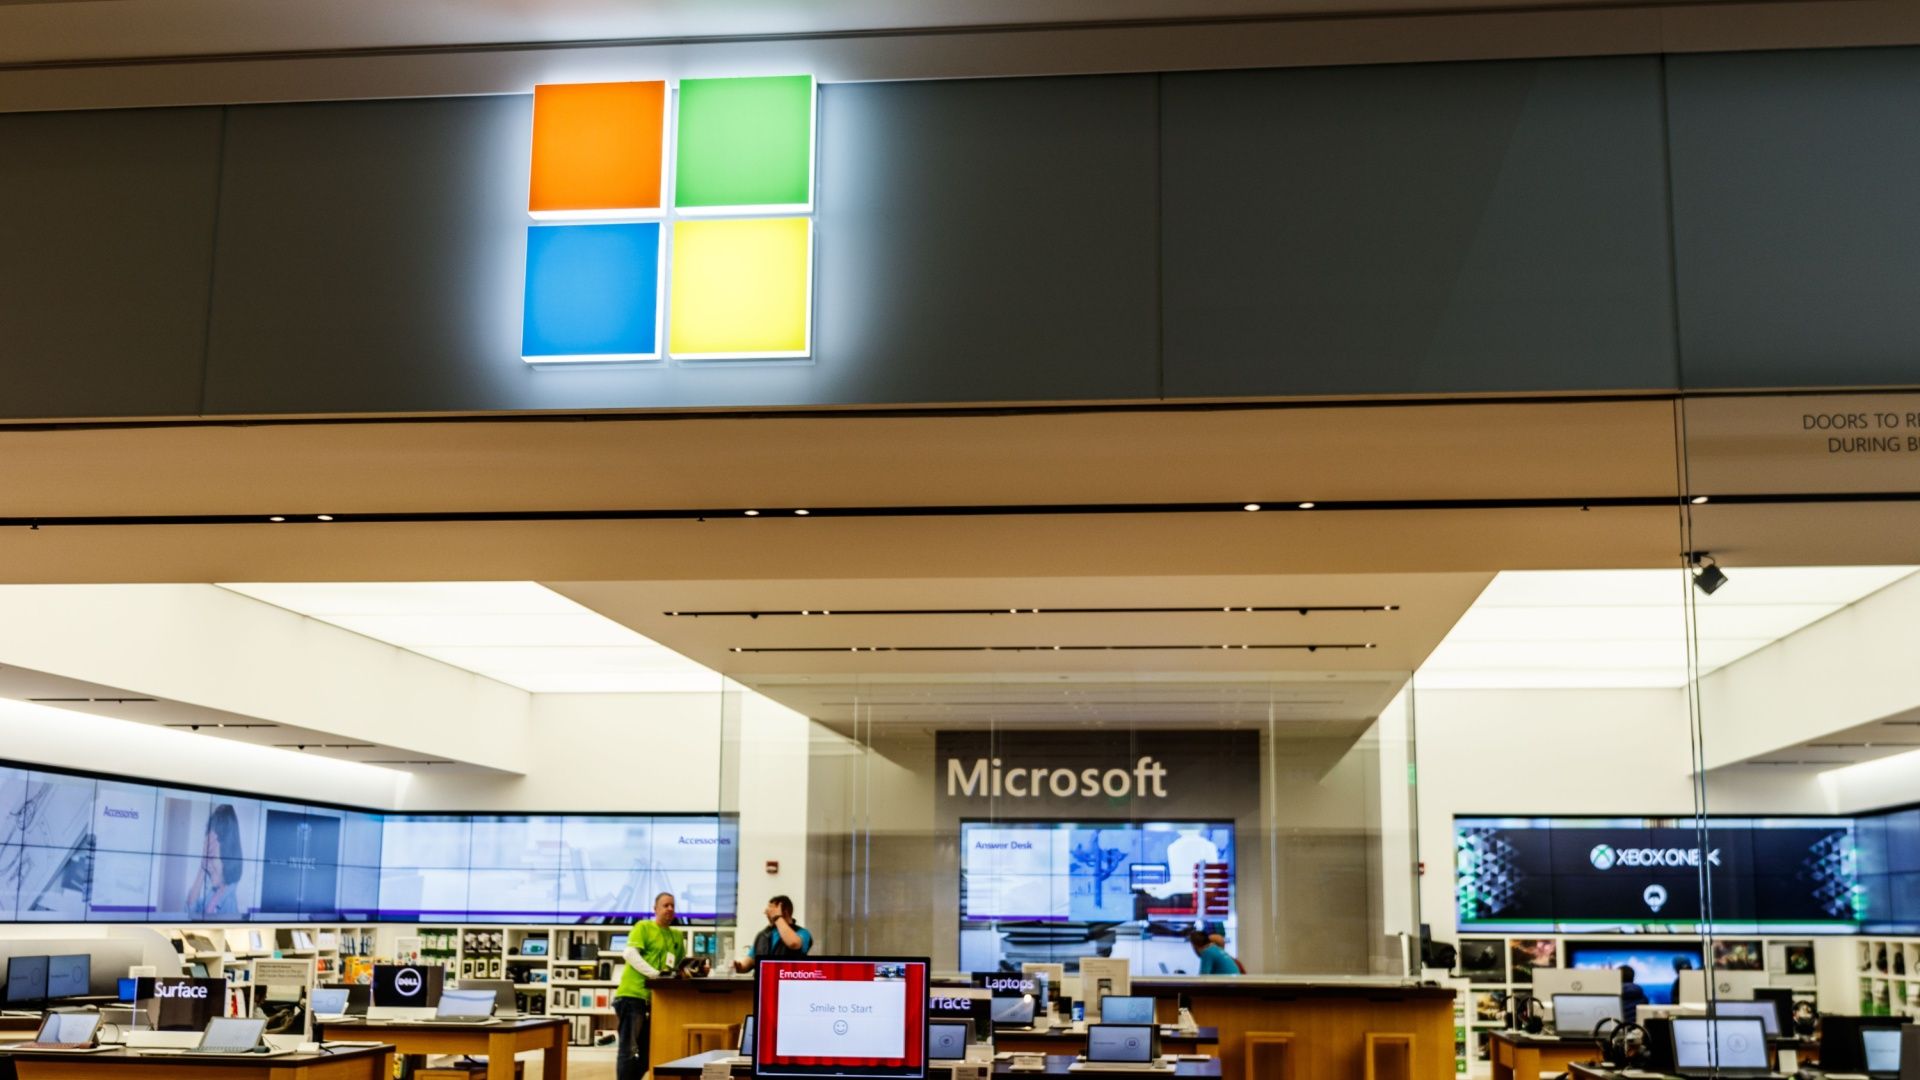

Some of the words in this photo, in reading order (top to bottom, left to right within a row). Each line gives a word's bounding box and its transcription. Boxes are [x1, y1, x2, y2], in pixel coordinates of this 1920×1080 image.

[1803, 413, 1868, 430] DOORS
[1874, 412, 1899, 429] TO
[1828, 436, 1900, 453] DURING
[1908, 435, 1920, 452] B
[947, 756, 1168, 797] Microsoft
[975, 841, 1009, 849] Answer
[1010, 841, 1033, 849] Desk
[398, 977, 418, 986] DELL
[779, 969, 815, 979] Emotion
[154, 981, 208, 998] Surface
[985, 976, 1035, 992] Laptops
[809, 1002, 835, 1013] Smile
[838, 1003, 848, 1013] to
[850, 1003, 872, 1013] Start
[930, 993, 971, 1010] rface
